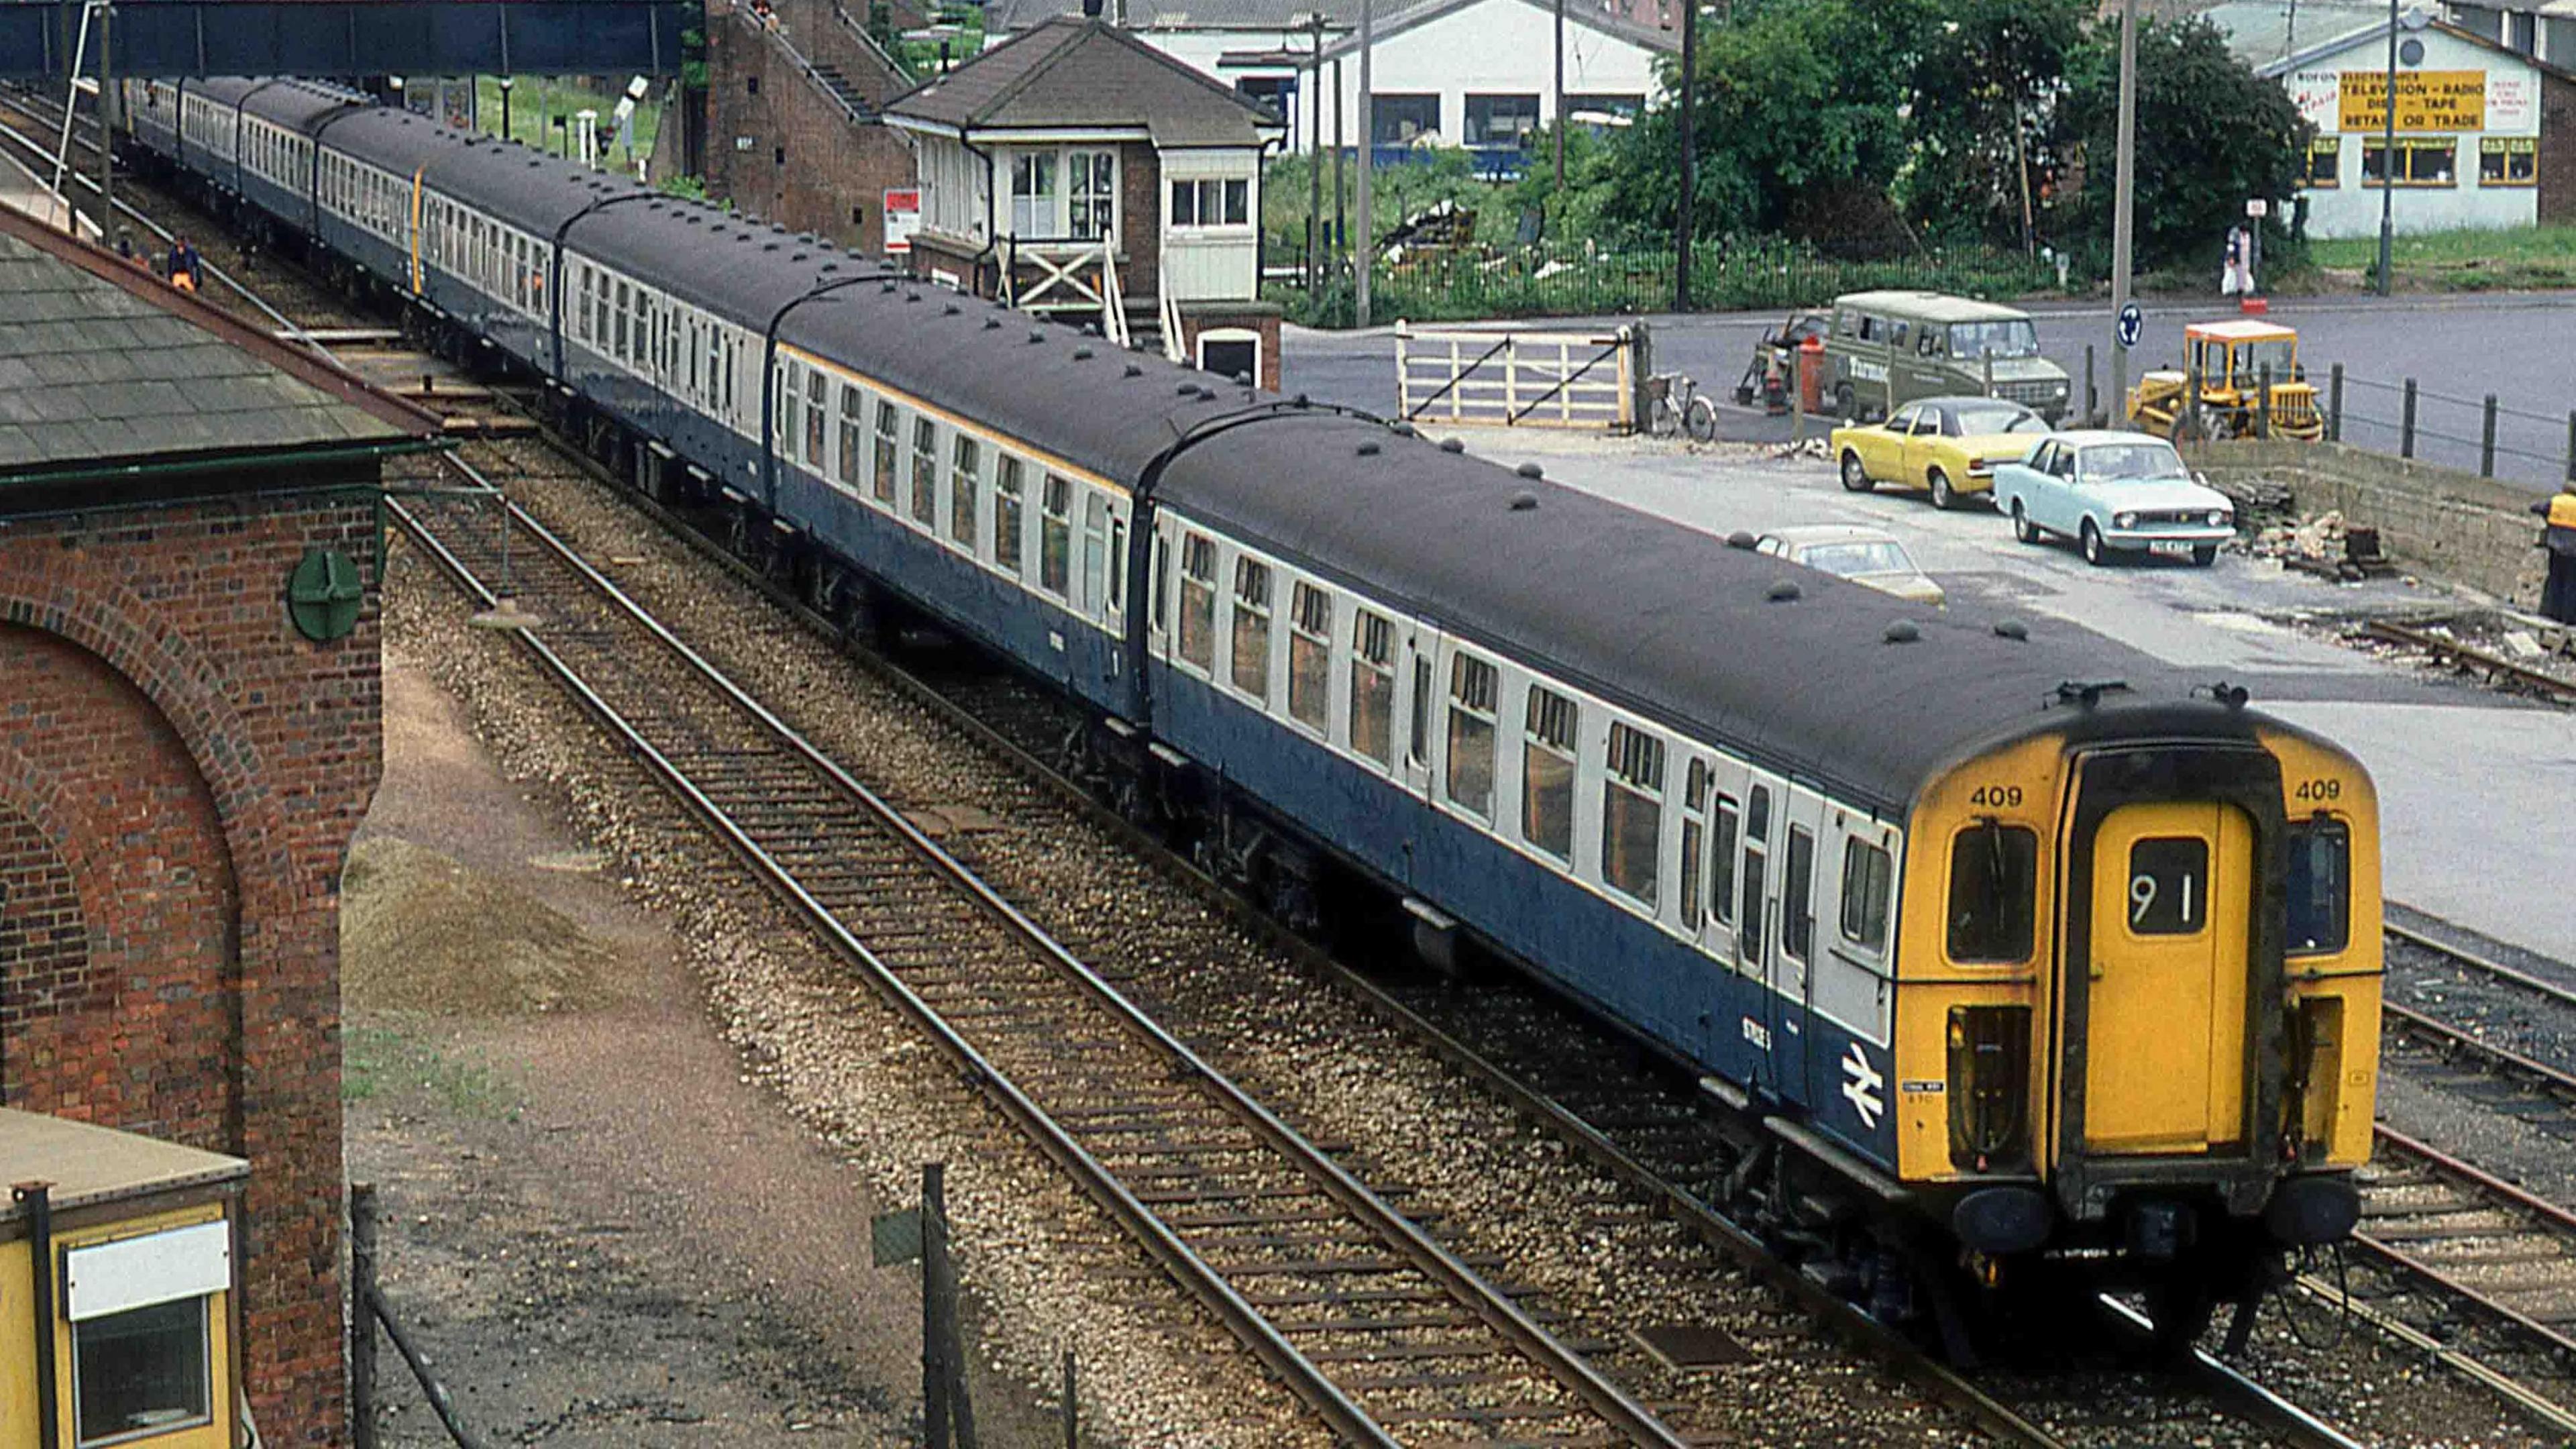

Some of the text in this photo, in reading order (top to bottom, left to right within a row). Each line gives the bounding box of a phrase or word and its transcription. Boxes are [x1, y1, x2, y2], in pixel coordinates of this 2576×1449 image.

[2444, 83, 2485, 95] RADIO
[2424, 98, 2457, 109] TAPE
[2345, 115, 2479, 126] RETAI OR TRADE
[2296, 780, 2340, 800] 409
[1970, 786, 2022, 808] 409
